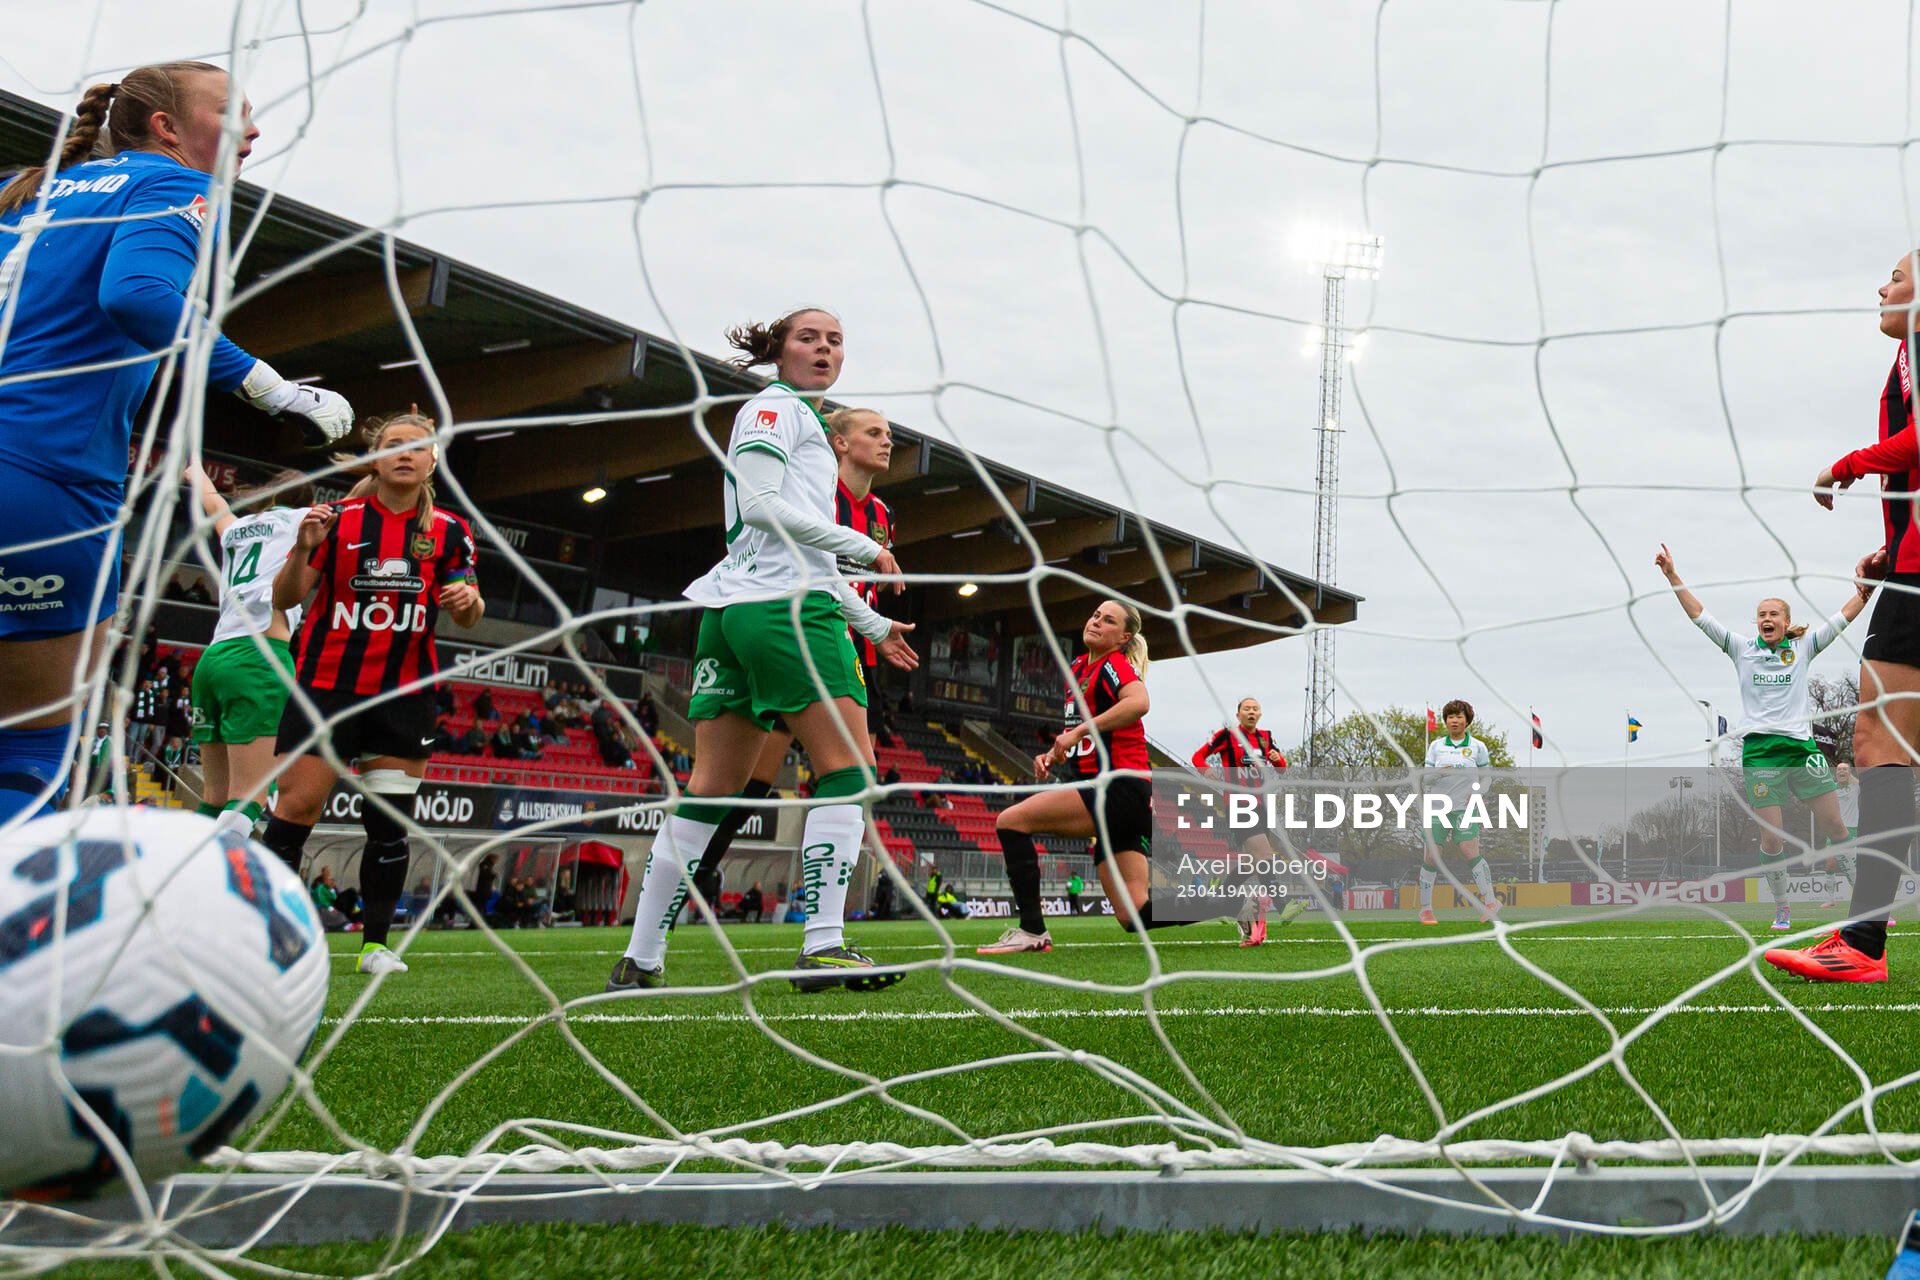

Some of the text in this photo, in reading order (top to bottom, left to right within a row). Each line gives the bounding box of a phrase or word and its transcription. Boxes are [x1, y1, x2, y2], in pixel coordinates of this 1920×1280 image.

[226, 542, 264, 587] 14
[332, 595, 428, 633] NÖJD
[450, 650, 549, 686] stadium
[1753, 673, 1792, 683] PROJOB
[414, 789, 474, 823] NÖJD
[518, 801, 583, 820] ALLSVENSKAN
[617, 803, 665, 831] NÖJD
[966, 897, 1012, 917] stadium
[1589, 881, 1727, 905] BEVEGO
